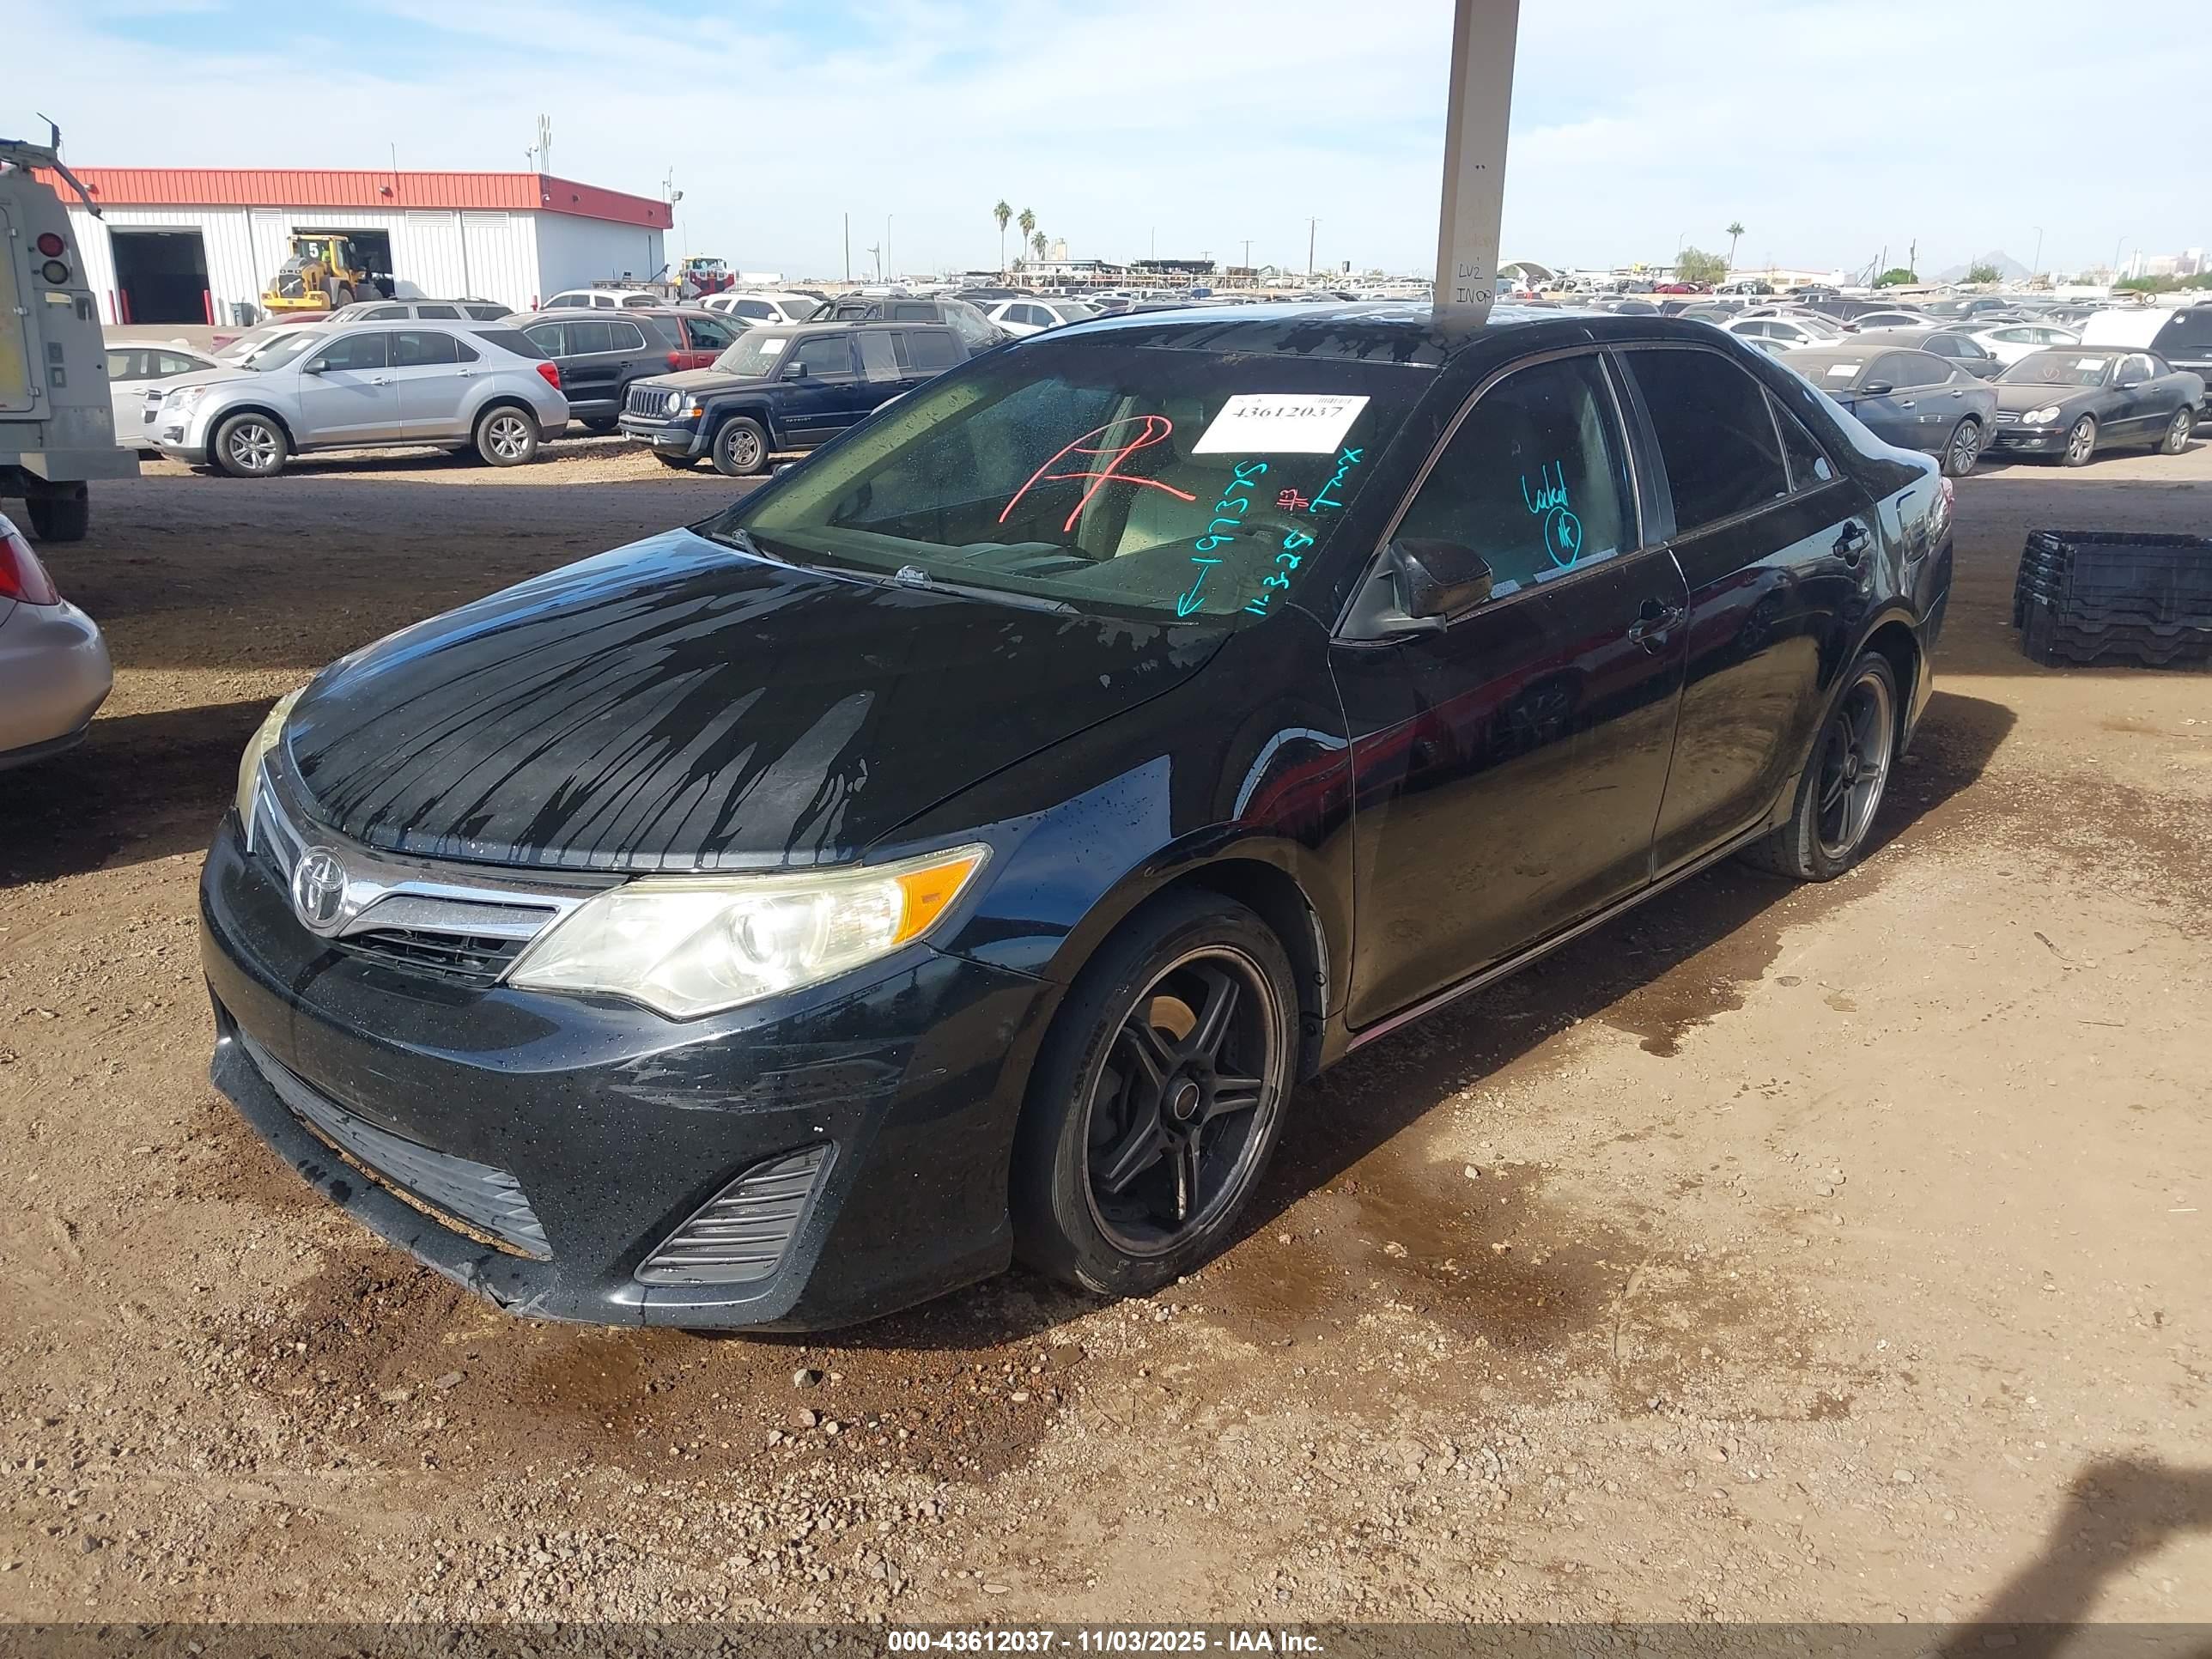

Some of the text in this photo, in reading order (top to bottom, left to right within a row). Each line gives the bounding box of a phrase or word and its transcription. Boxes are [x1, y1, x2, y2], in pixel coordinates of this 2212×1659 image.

[309, 242, 319, 258] 5
[1459, 263, 1483, 279] LV2
[1231, 406, 1345, 418] 43612037
